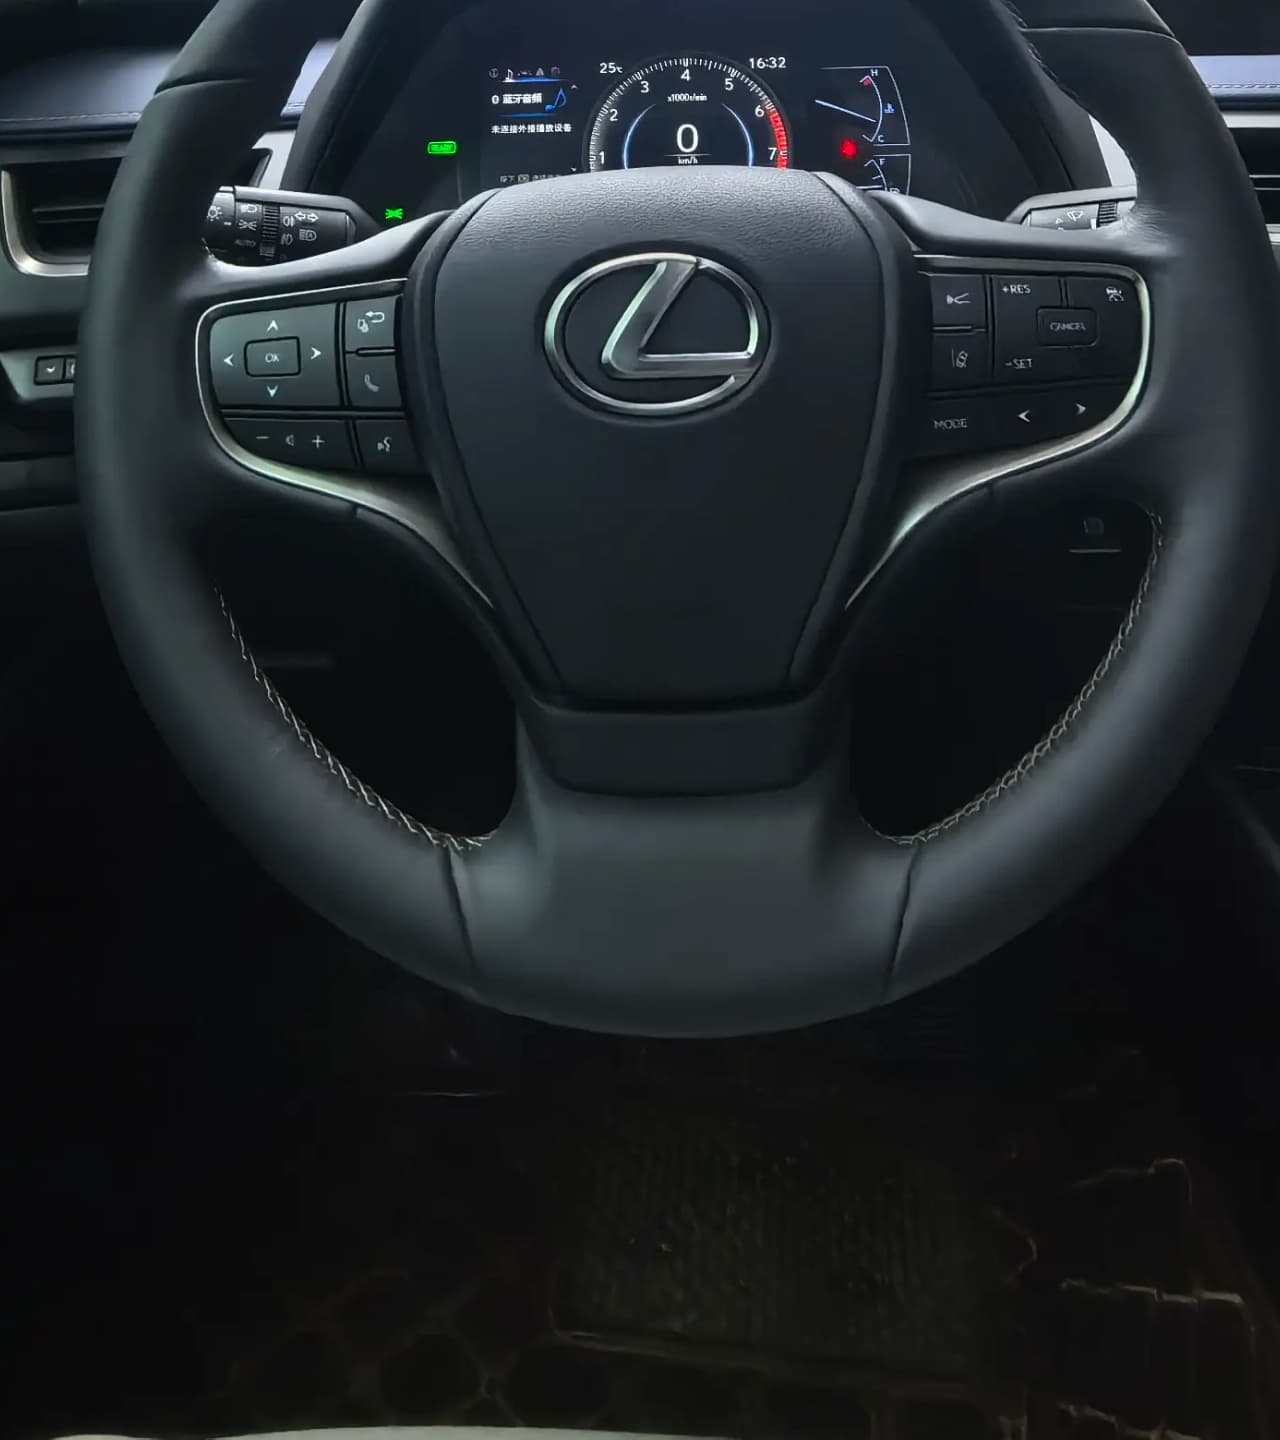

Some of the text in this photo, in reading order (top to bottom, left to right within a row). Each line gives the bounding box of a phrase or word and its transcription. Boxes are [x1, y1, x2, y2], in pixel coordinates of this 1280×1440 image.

[748, 56, 787, 70] 16:32
[680, 68, 691, 82] 4
[640, 80, 650, 94] 3
[725, 78, 735, 92] 5
[609, 109, 619, 122] 2
[754, 104, 765, 118] 6
[676, 123, 700, 154] 0
[598, 151, 606, 165] 1
[677, 156, 699, 165] km/h
[767, 147, 777, 161] 7
[933, 418, 969, 430] MODE
